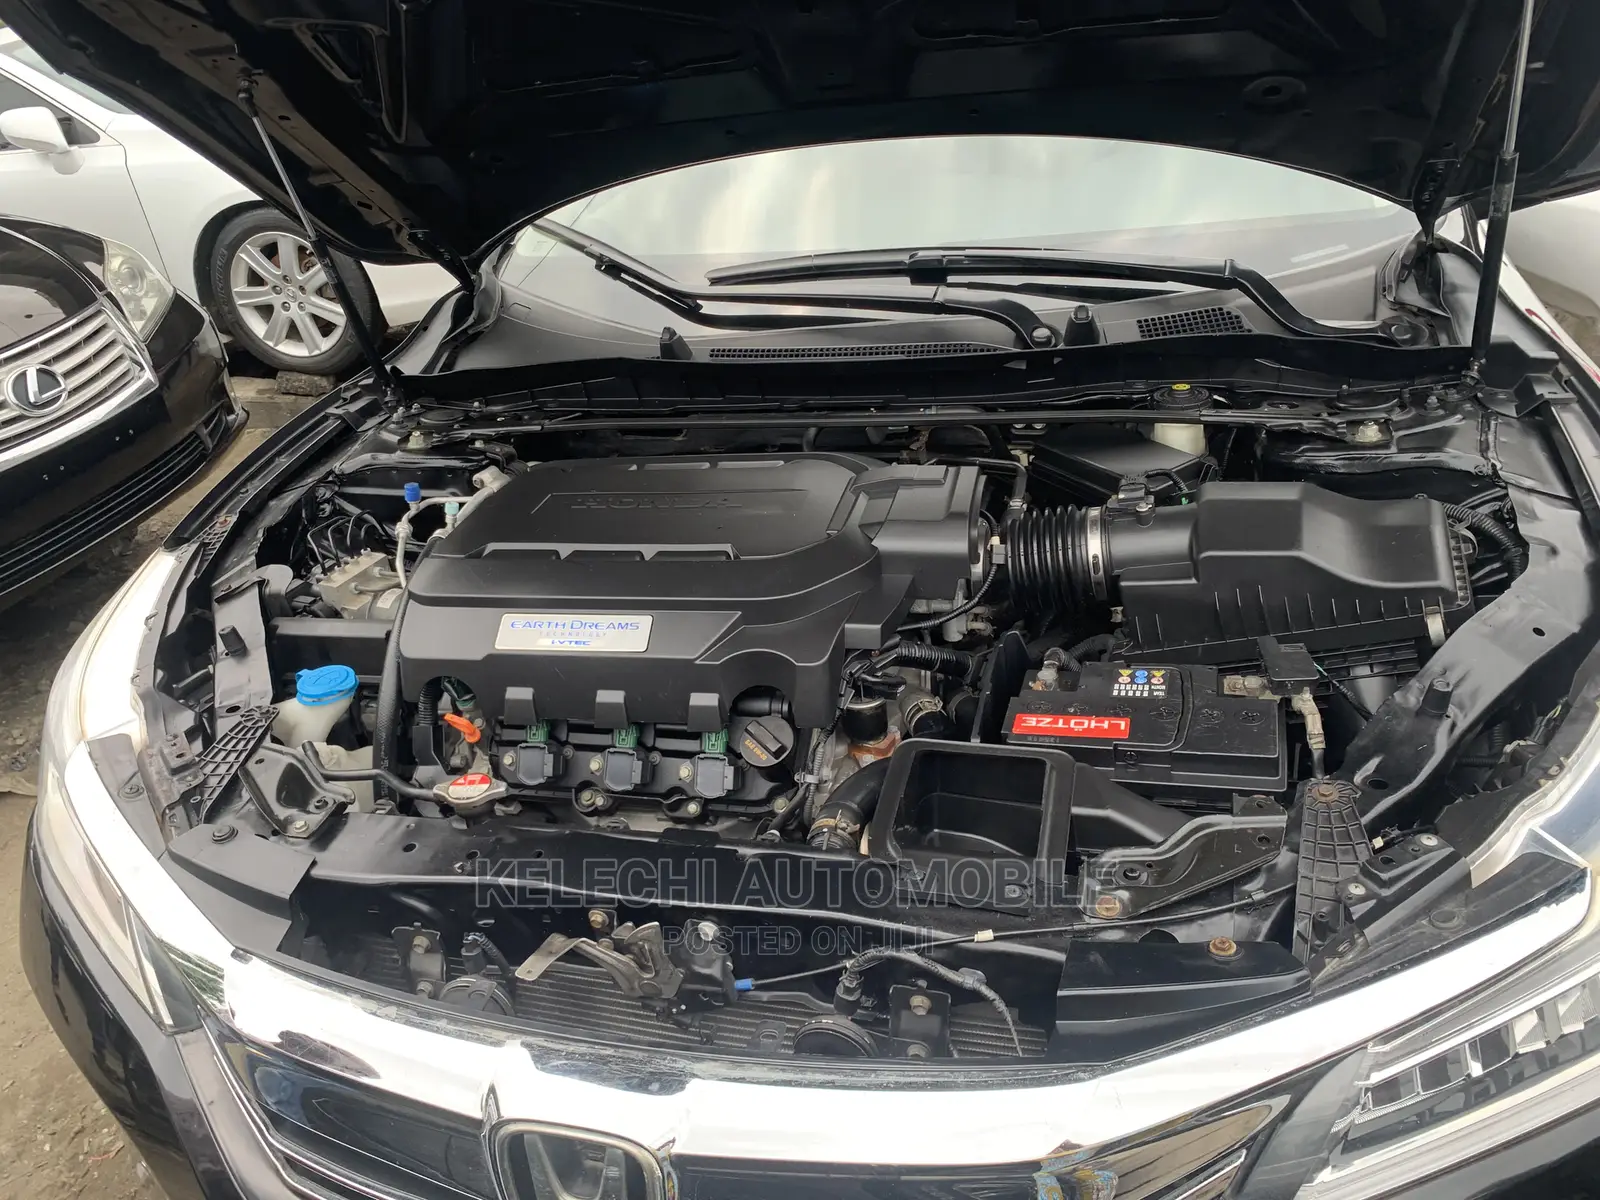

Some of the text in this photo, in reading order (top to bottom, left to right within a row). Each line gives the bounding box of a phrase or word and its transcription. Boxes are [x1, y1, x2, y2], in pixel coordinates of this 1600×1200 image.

[570, 498, 743, 510] HONDA
[510, 620, 566, 629] EARTH
[1021, 717, 1126, 731] LHÖTZE
